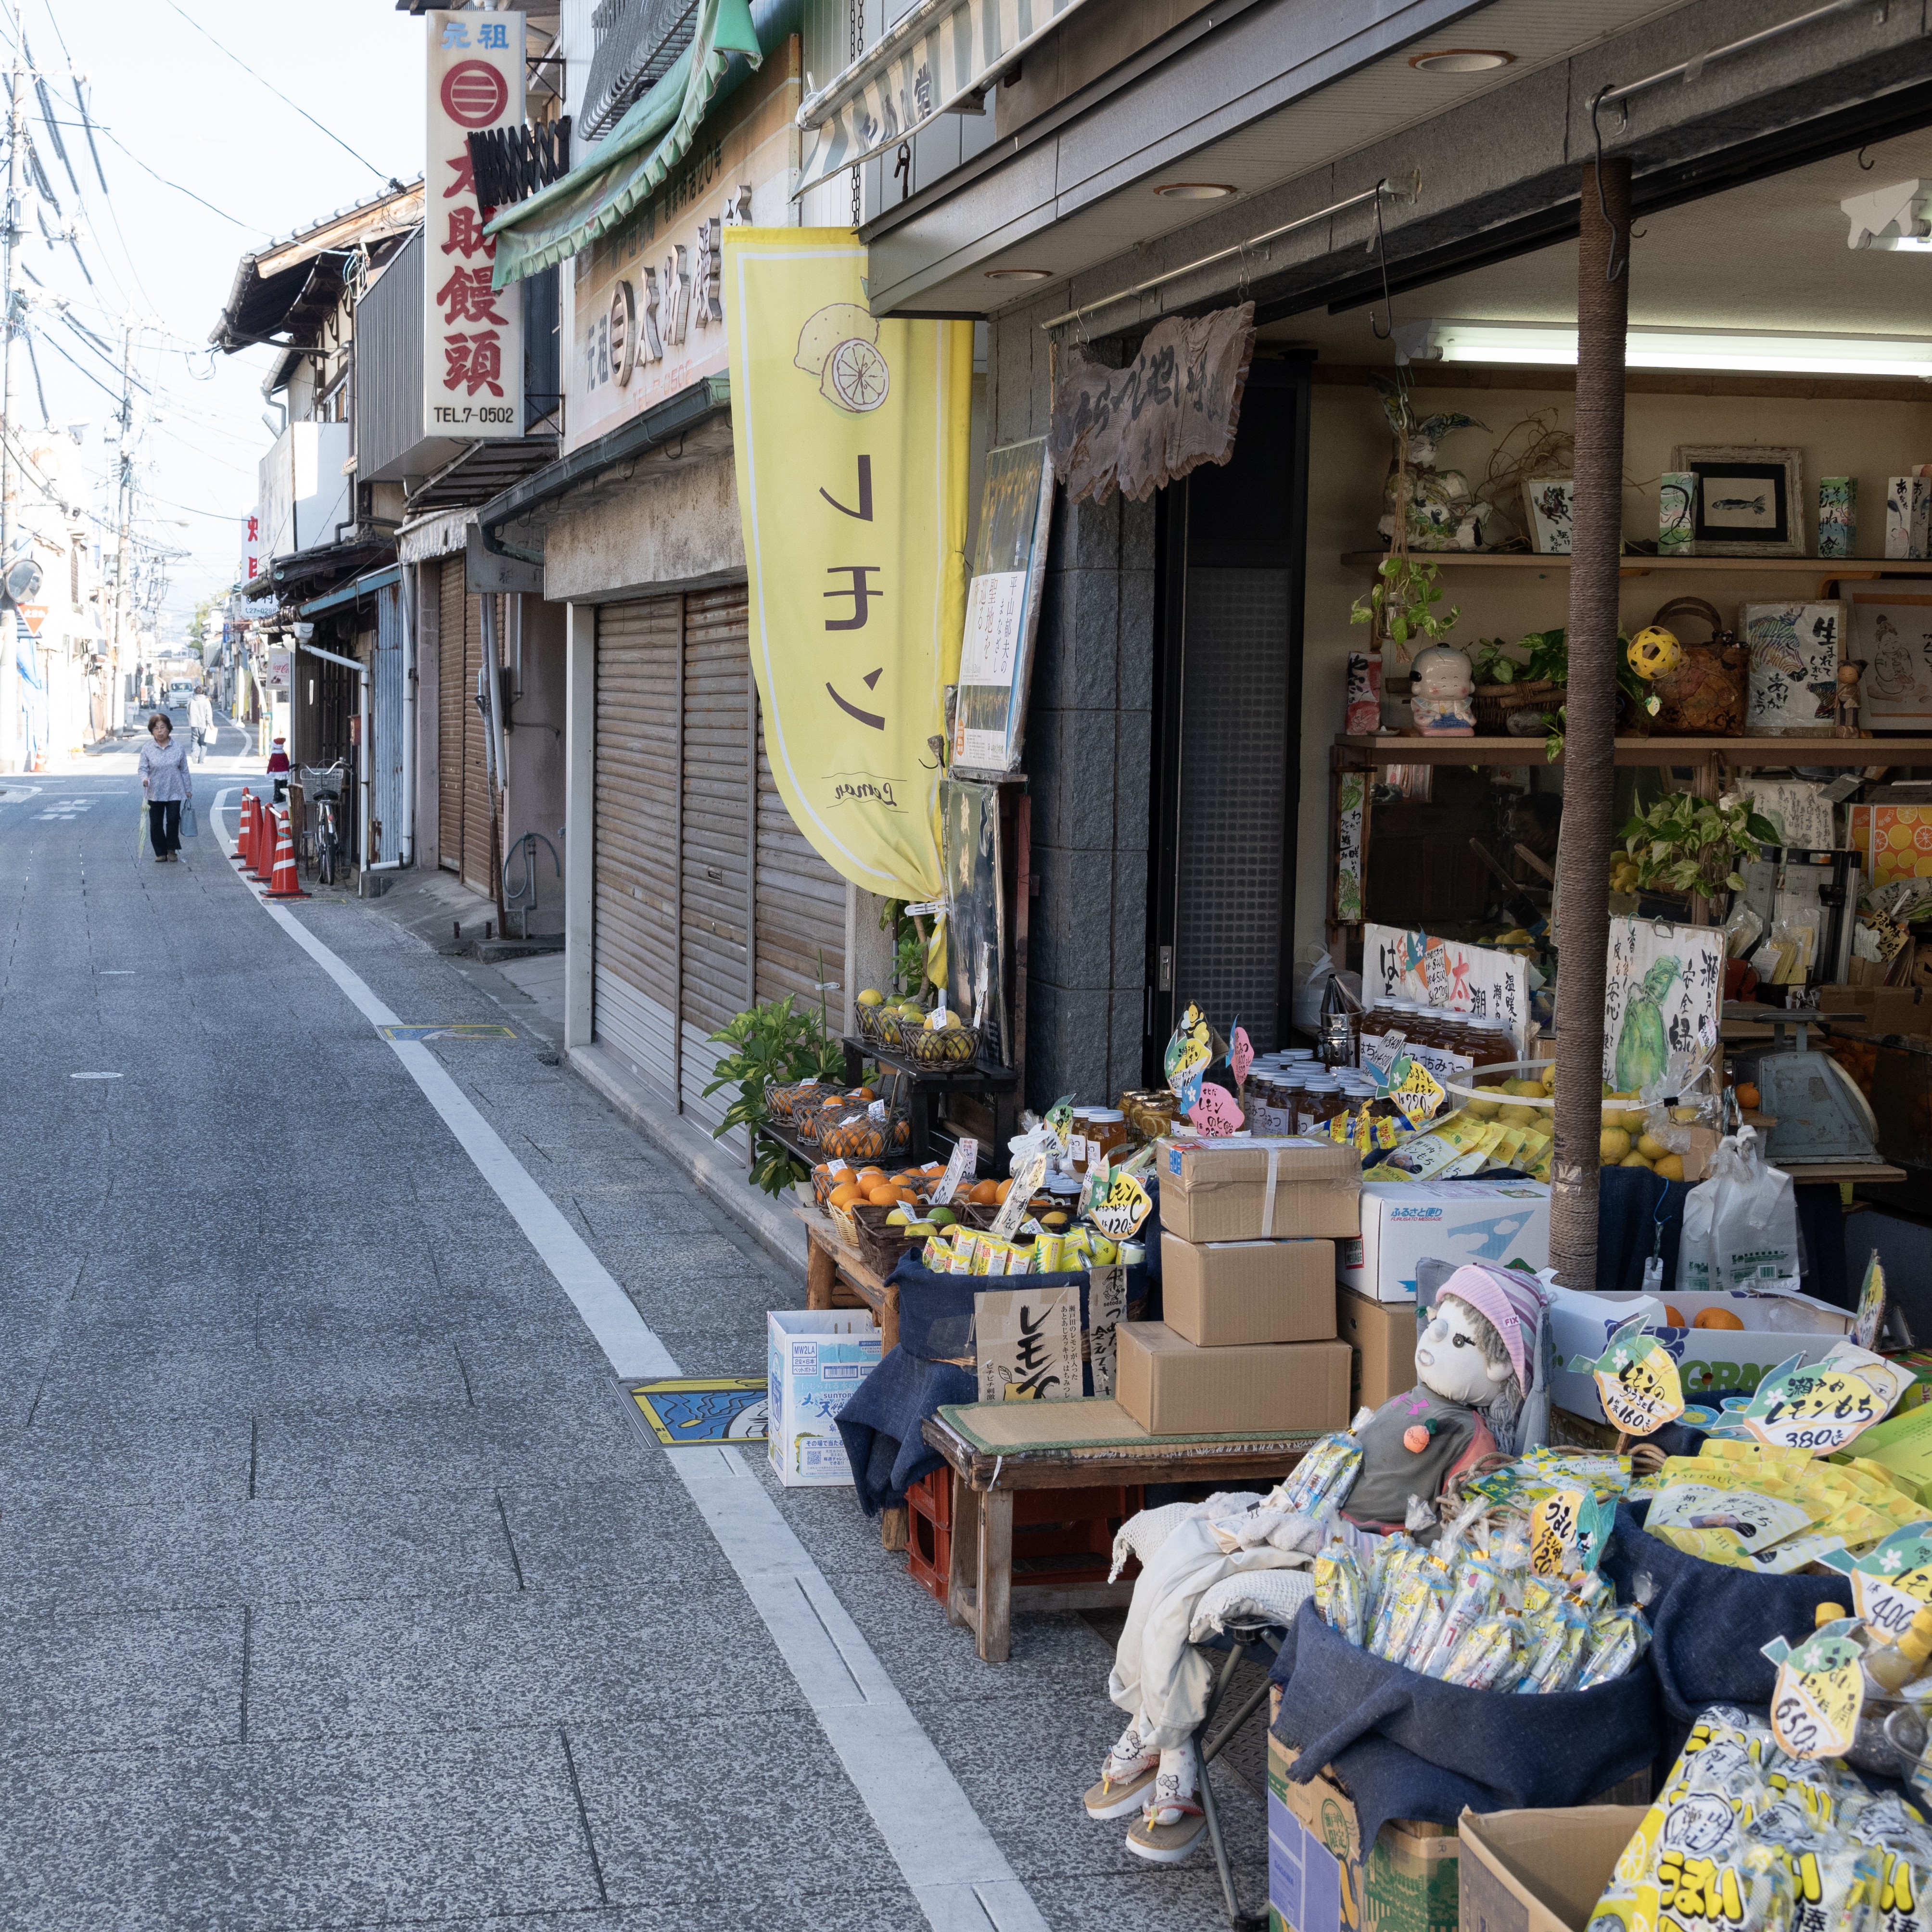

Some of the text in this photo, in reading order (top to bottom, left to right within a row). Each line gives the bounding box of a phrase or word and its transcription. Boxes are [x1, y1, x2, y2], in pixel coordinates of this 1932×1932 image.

[441, 23, 509, 49] 元祖
[978, 578, 989, 630] 巡る
[984, 577, 998, 660] 聖地を
[1198, 1097, 1223, 1114] レモン
[1390, 1207, 1443, 1217] ふるさと便り
[1504, 1316, 1519, 1326] FIX
[794, 1346, 815, 1355] MW2LA
[1068, 1305, 1078, 1381] 瀬戸田のレモンが入った
[1787, 1377, 1845, 1398] 瀬戸内
[1618, 1407, 1645, 1427] 160
[1765, 1394, 1874, 1425] レモンもち
[1786, 1429, 1832, 1449] 380
[1329, 1829, 1347, 1850] 限定
